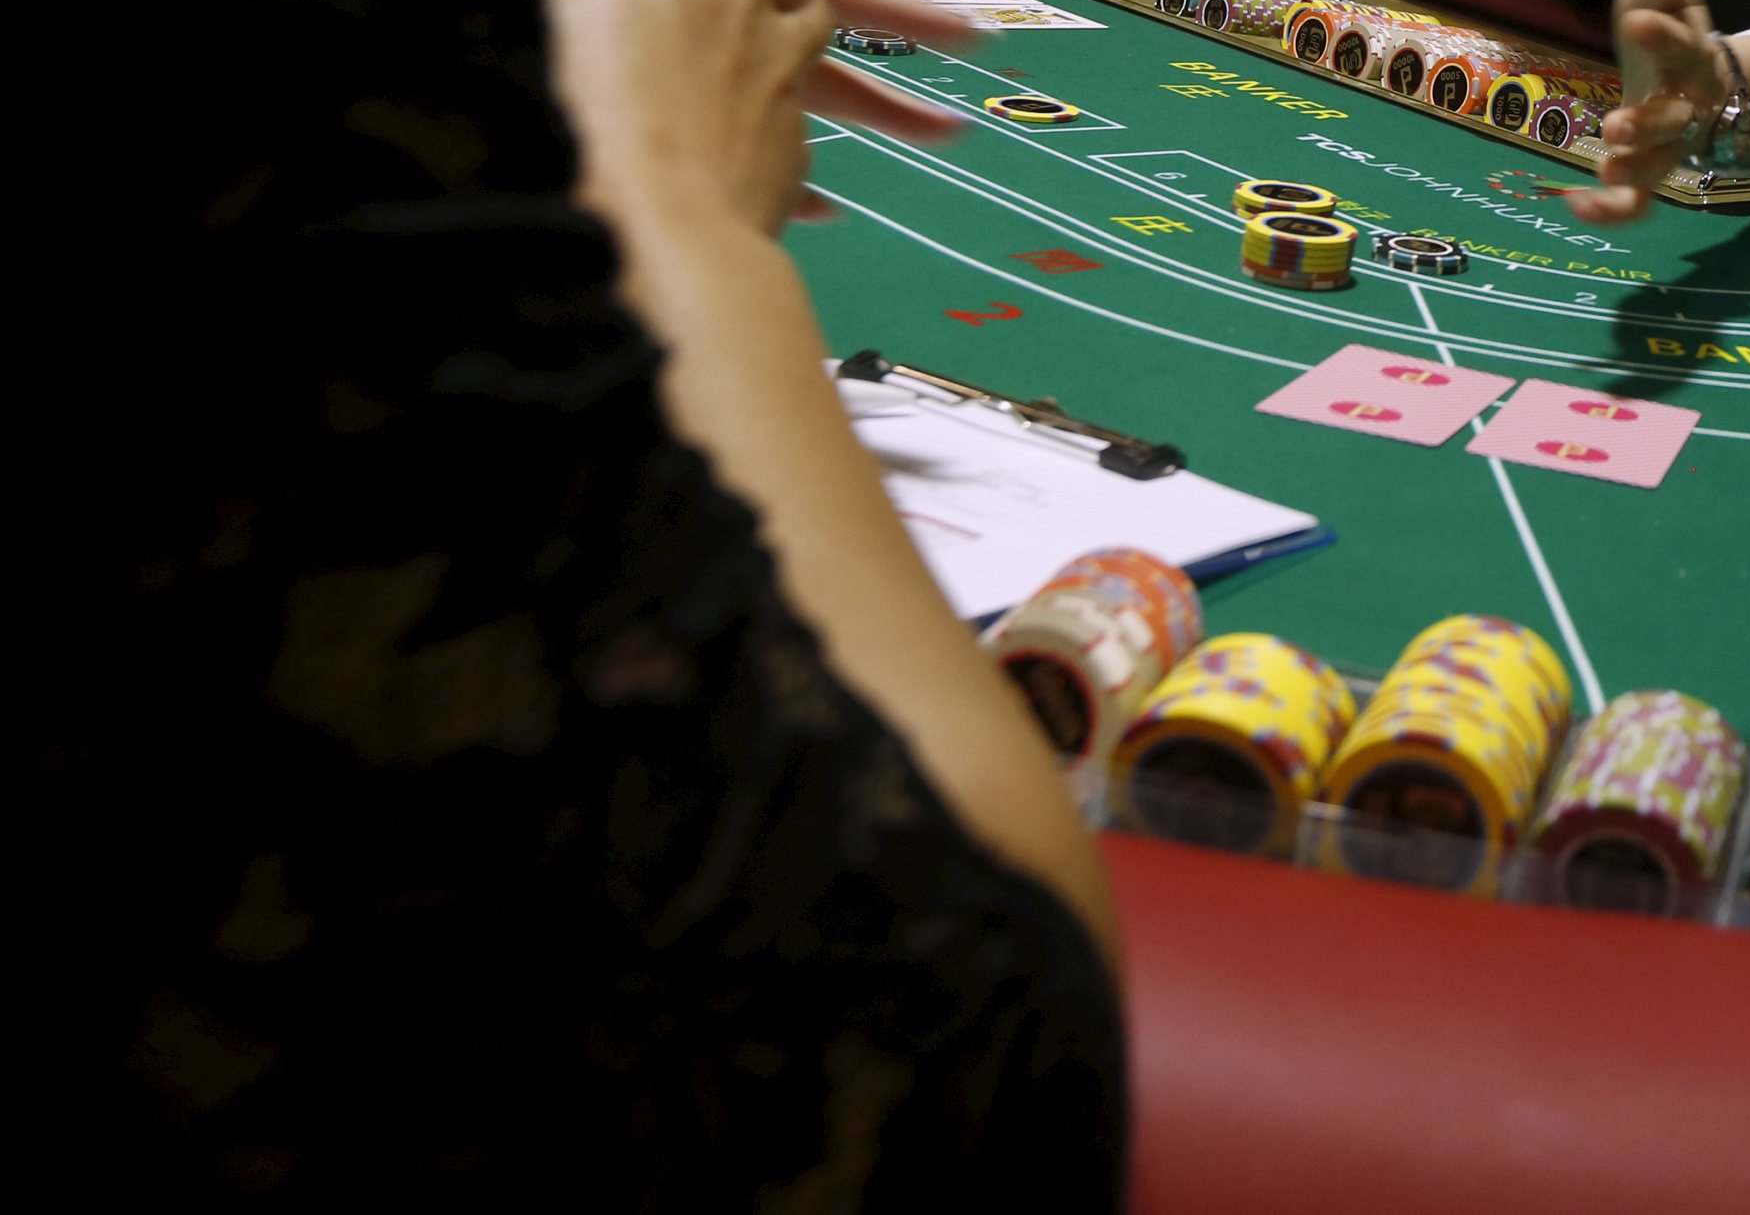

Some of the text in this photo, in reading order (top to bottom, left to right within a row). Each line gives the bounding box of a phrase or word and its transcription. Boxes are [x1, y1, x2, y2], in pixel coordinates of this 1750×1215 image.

[1440, 70, 1461, 81] 5000
[1169, 61, 1350, 121] BANKER
[1296, 132, 1631, 255] TCSJOHNHUXLEY
[1567, 261, 1653, 282] PAIR
[1574, 292, 1598, 306] 2
[943, 301, 1024, 327] 2
